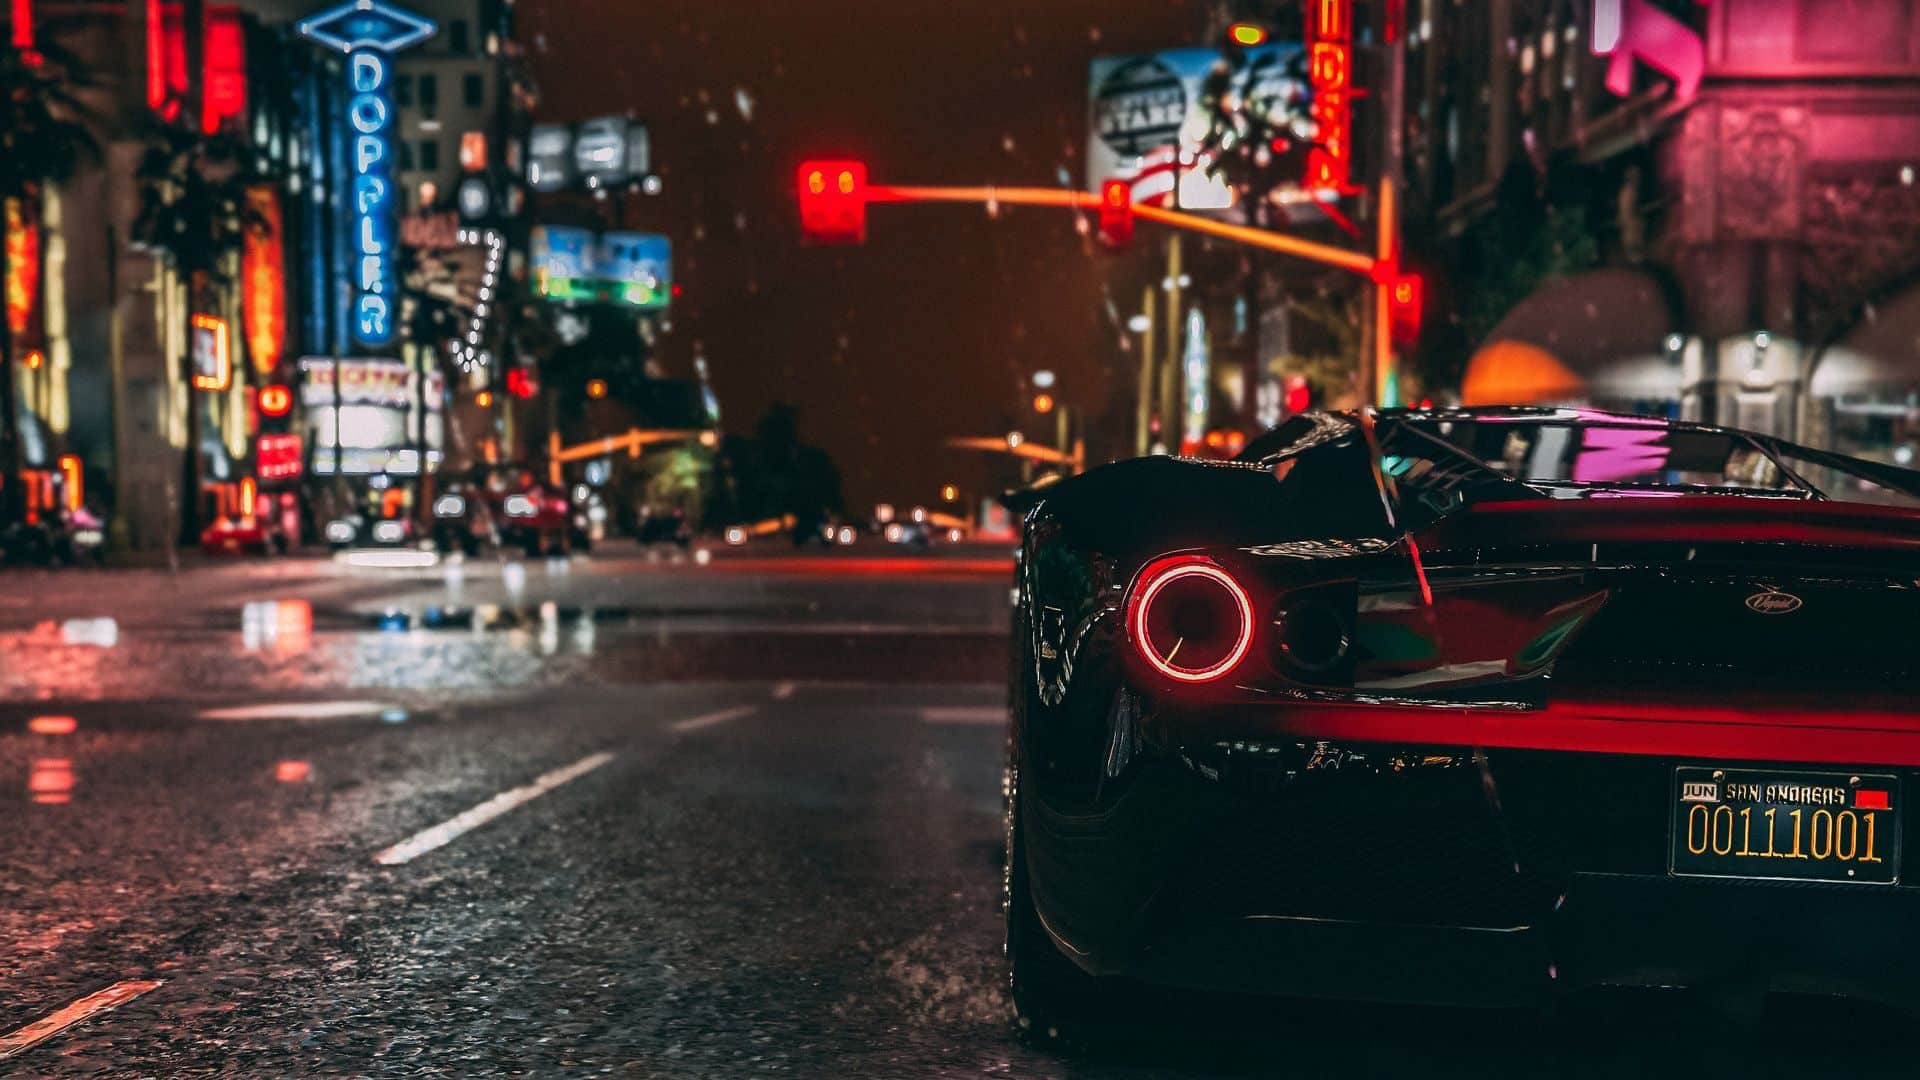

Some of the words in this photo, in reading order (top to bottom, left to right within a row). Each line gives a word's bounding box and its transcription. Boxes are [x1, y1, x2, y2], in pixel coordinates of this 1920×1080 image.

[352, 54, 387, 335] DOPPLER
[1684, 784, 1715, 798] JUN
[1726, 783, 1761, 802] SAN
[1766, 784, 1846, 804] ANDREAS
[1688, 804, 1882, 864] 00111001
